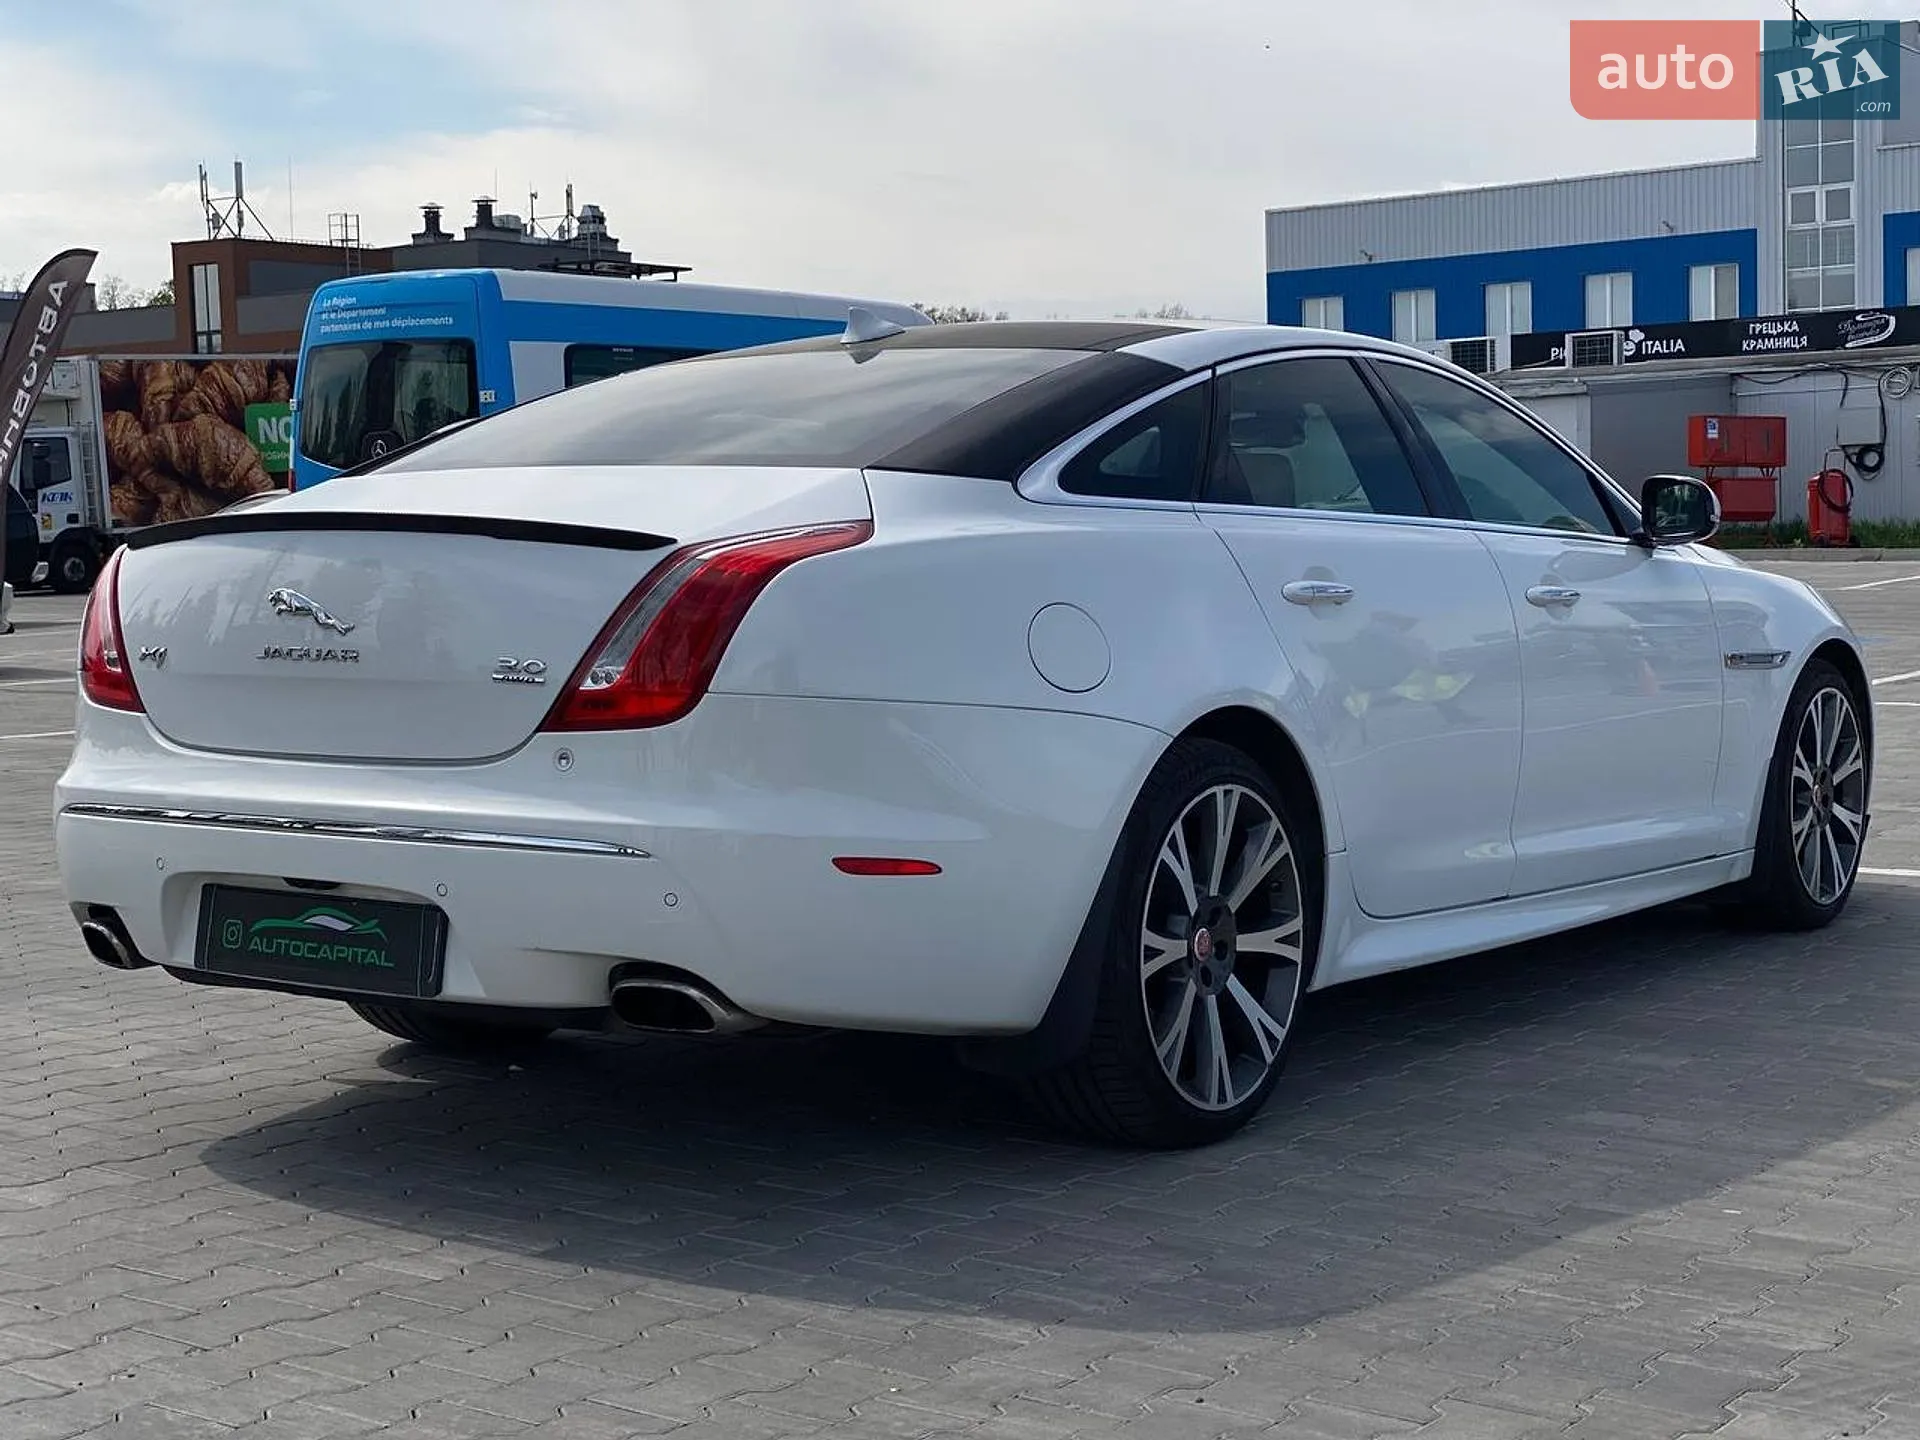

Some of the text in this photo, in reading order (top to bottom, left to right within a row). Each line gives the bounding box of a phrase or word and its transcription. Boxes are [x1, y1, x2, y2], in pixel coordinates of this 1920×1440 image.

[1749, 320, 1799, 336] ГРЕЦЬКА
[1642, 339, 1686, 355] ITALIA
[1742, 336, 1808, 351] КРАМНИЦЯ
[256, 645, 359, 663] JAGUAR
[250, 936, 394, 967] AUTOCAPITAL
